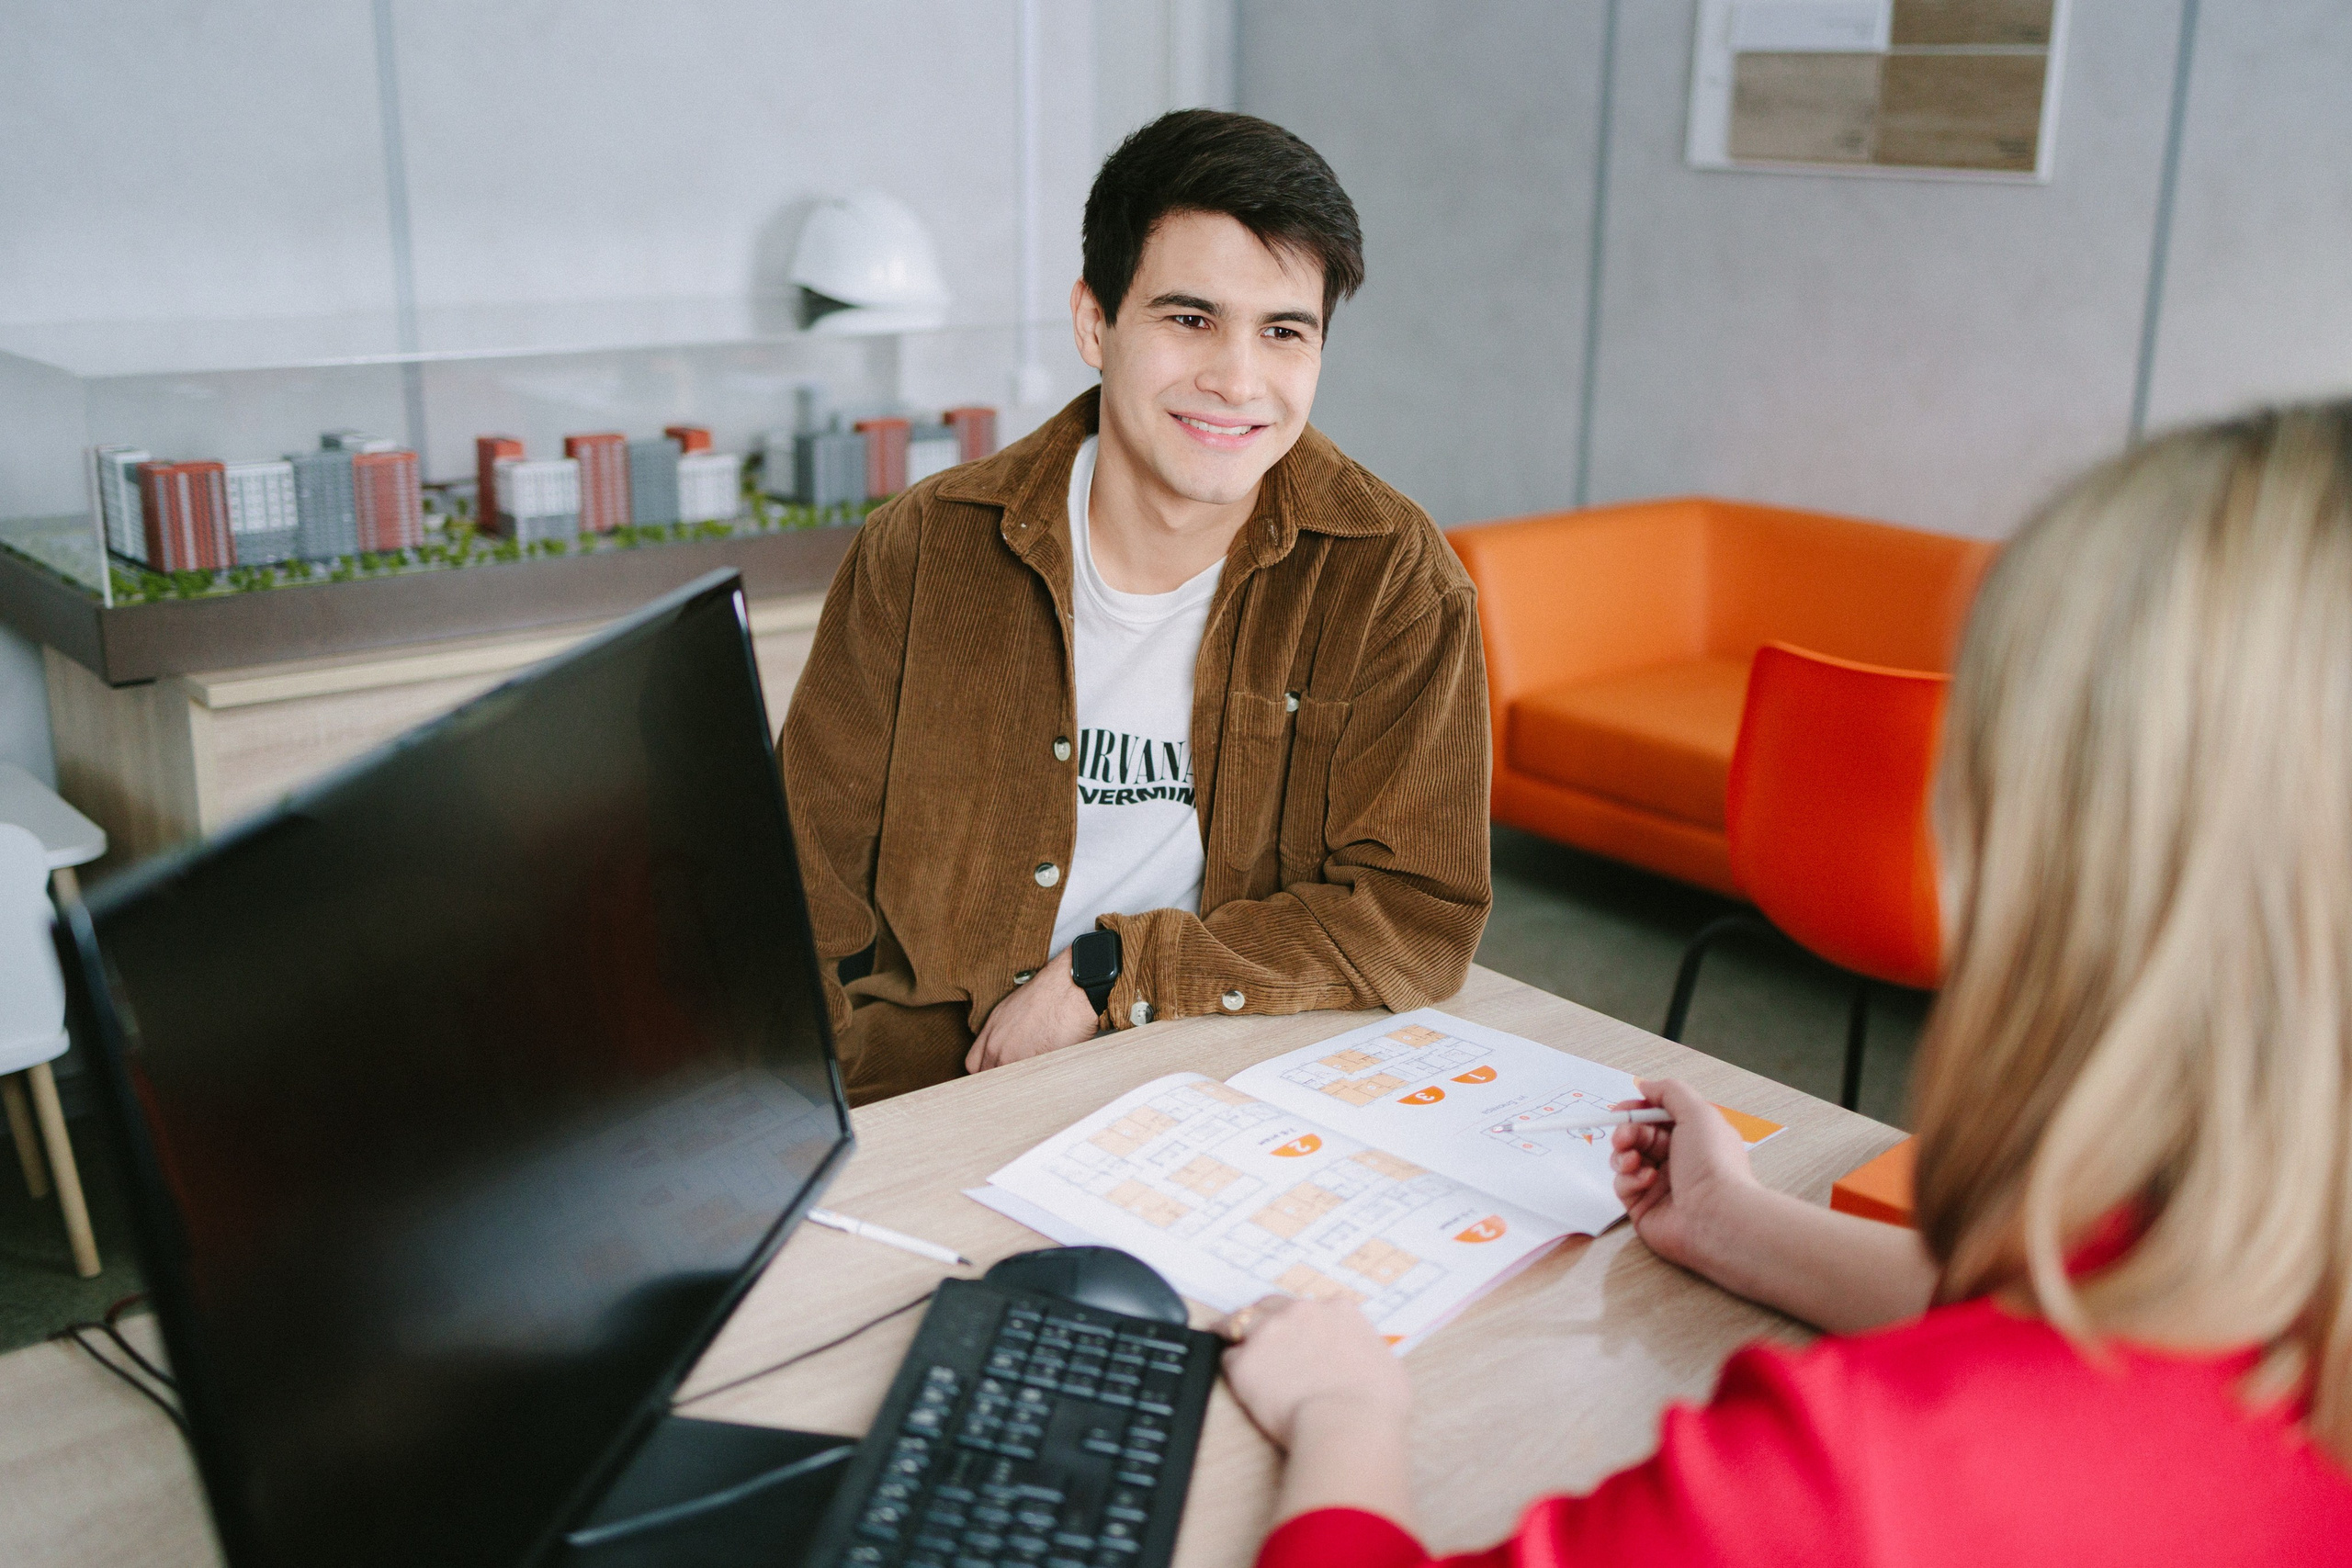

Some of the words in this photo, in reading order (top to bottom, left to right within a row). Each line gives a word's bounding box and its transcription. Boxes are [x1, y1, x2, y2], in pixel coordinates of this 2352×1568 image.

[1468, 1073, 1487, 1081] 1
[1415, 1092, 1435, 1101] 3
[1287, 1140, 1313, 1153] 2
[1471, 1224, 1497, 1238] 2
